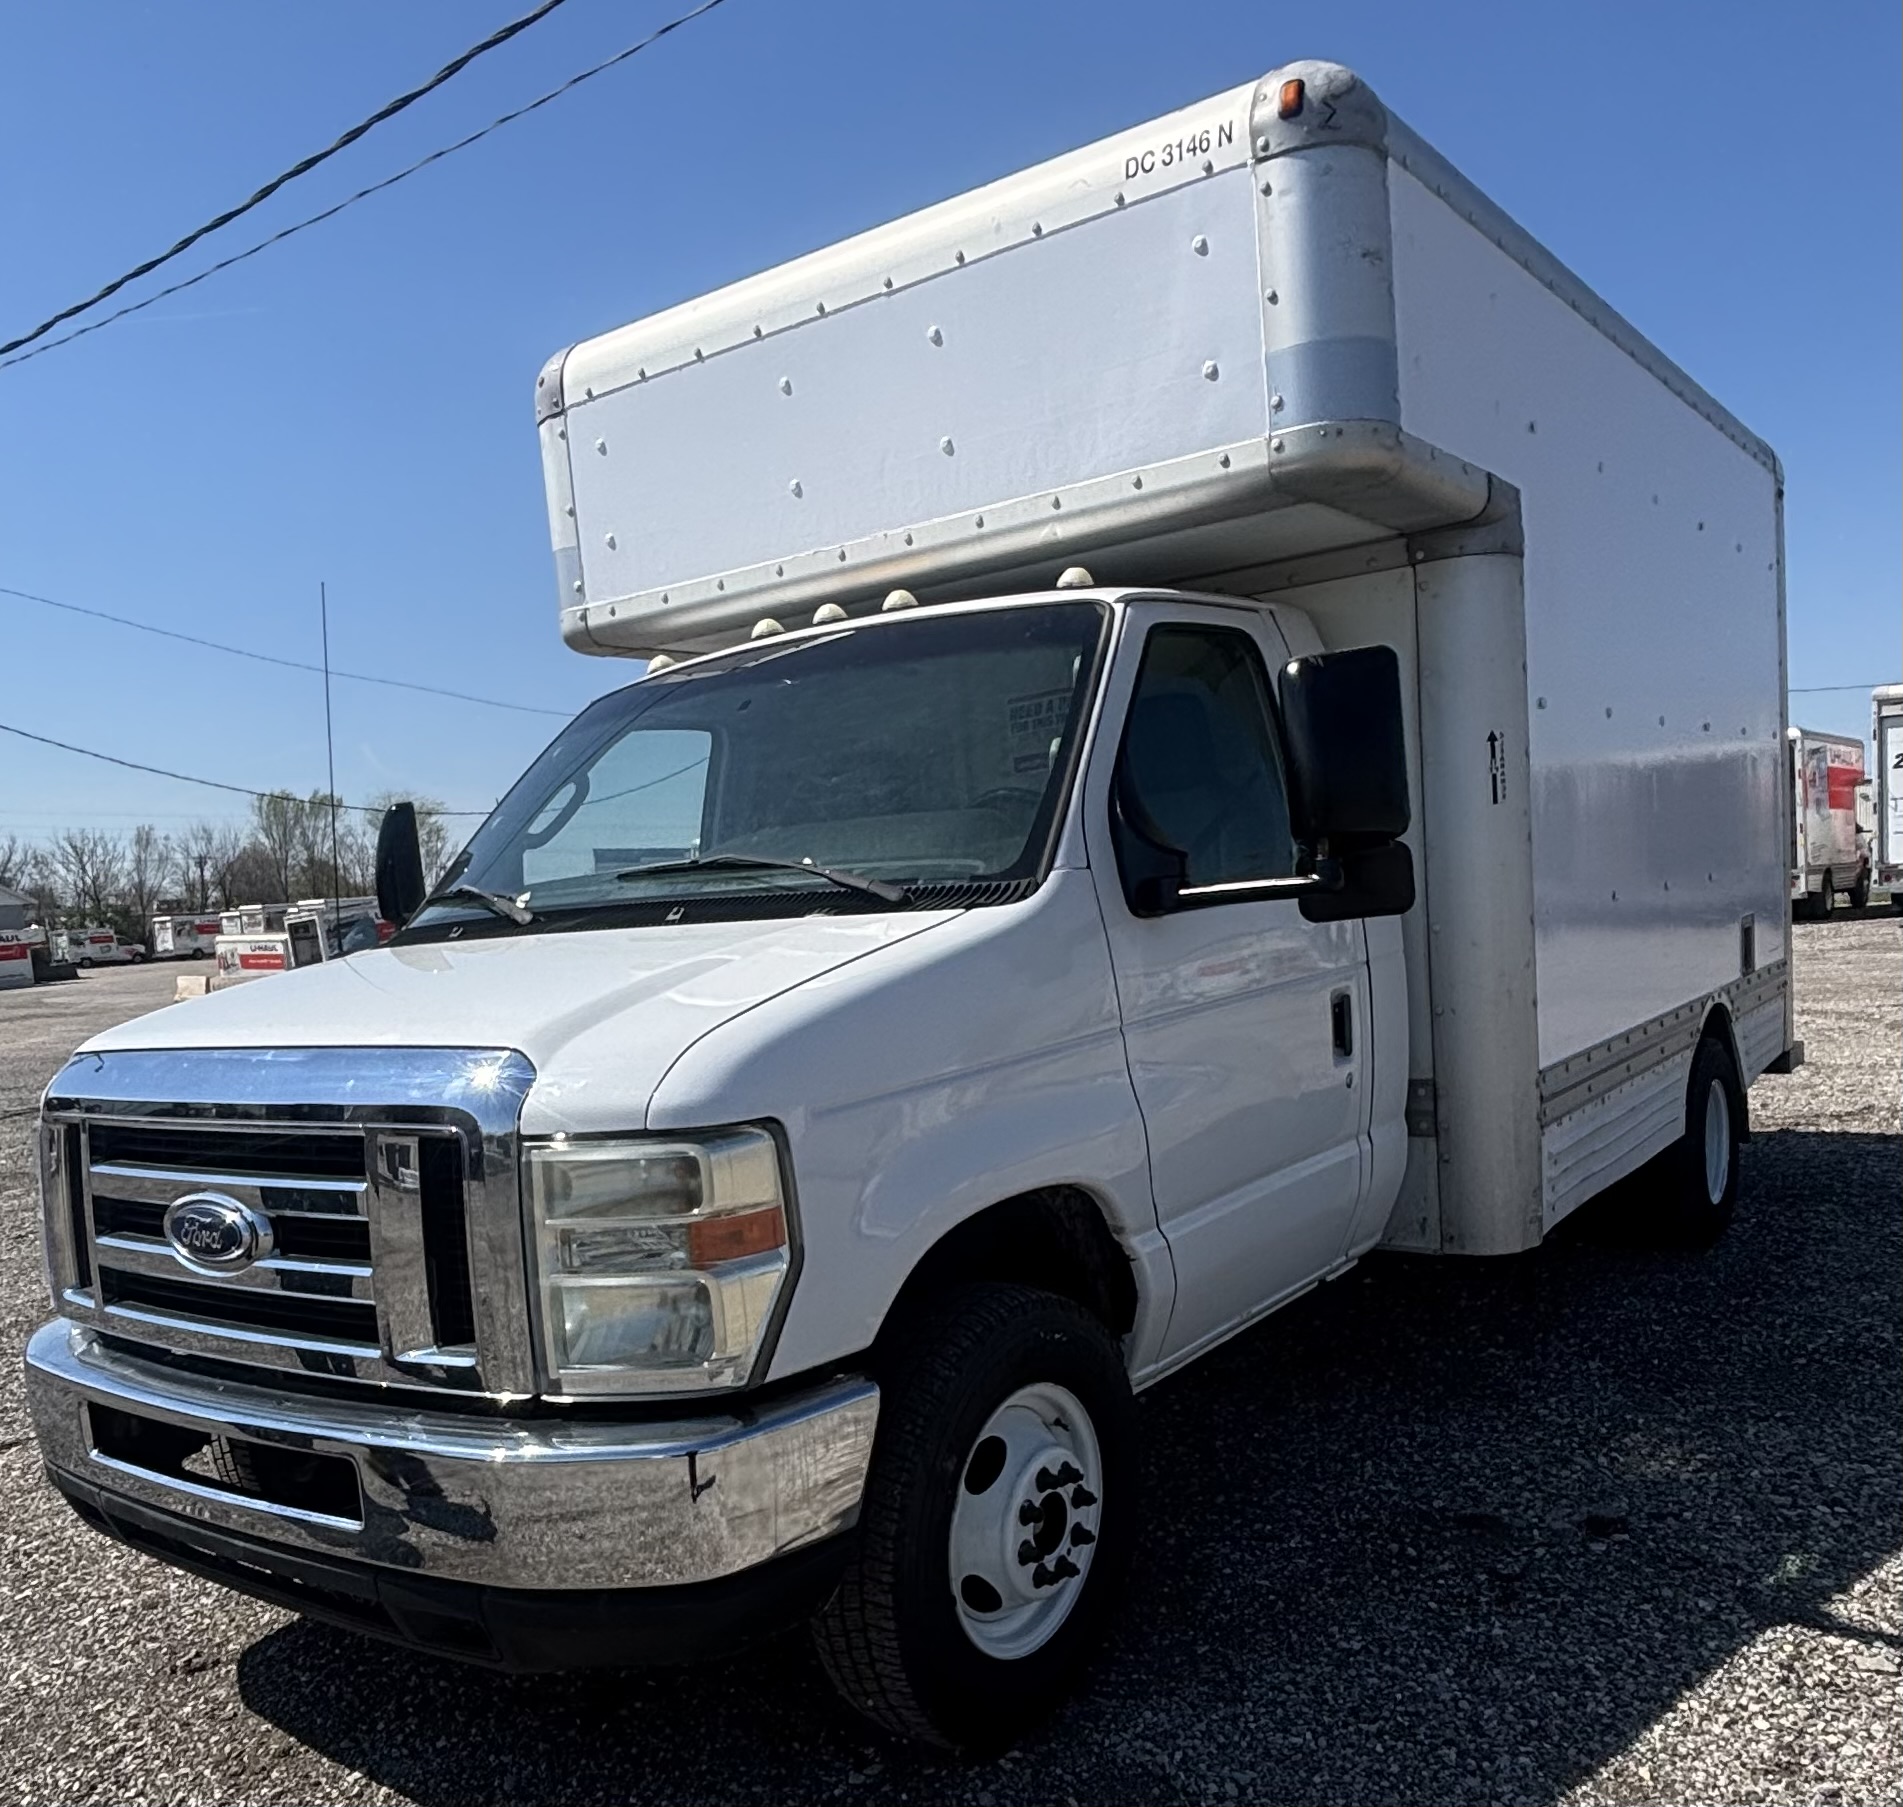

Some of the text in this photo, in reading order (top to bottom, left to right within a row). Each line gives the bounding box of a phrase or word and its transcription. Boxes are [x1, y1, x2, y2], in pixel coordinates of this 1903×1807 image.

[1125, 120, 1233, 179] DC 3146 N
[181, 1214, 225, 1249] Ford
